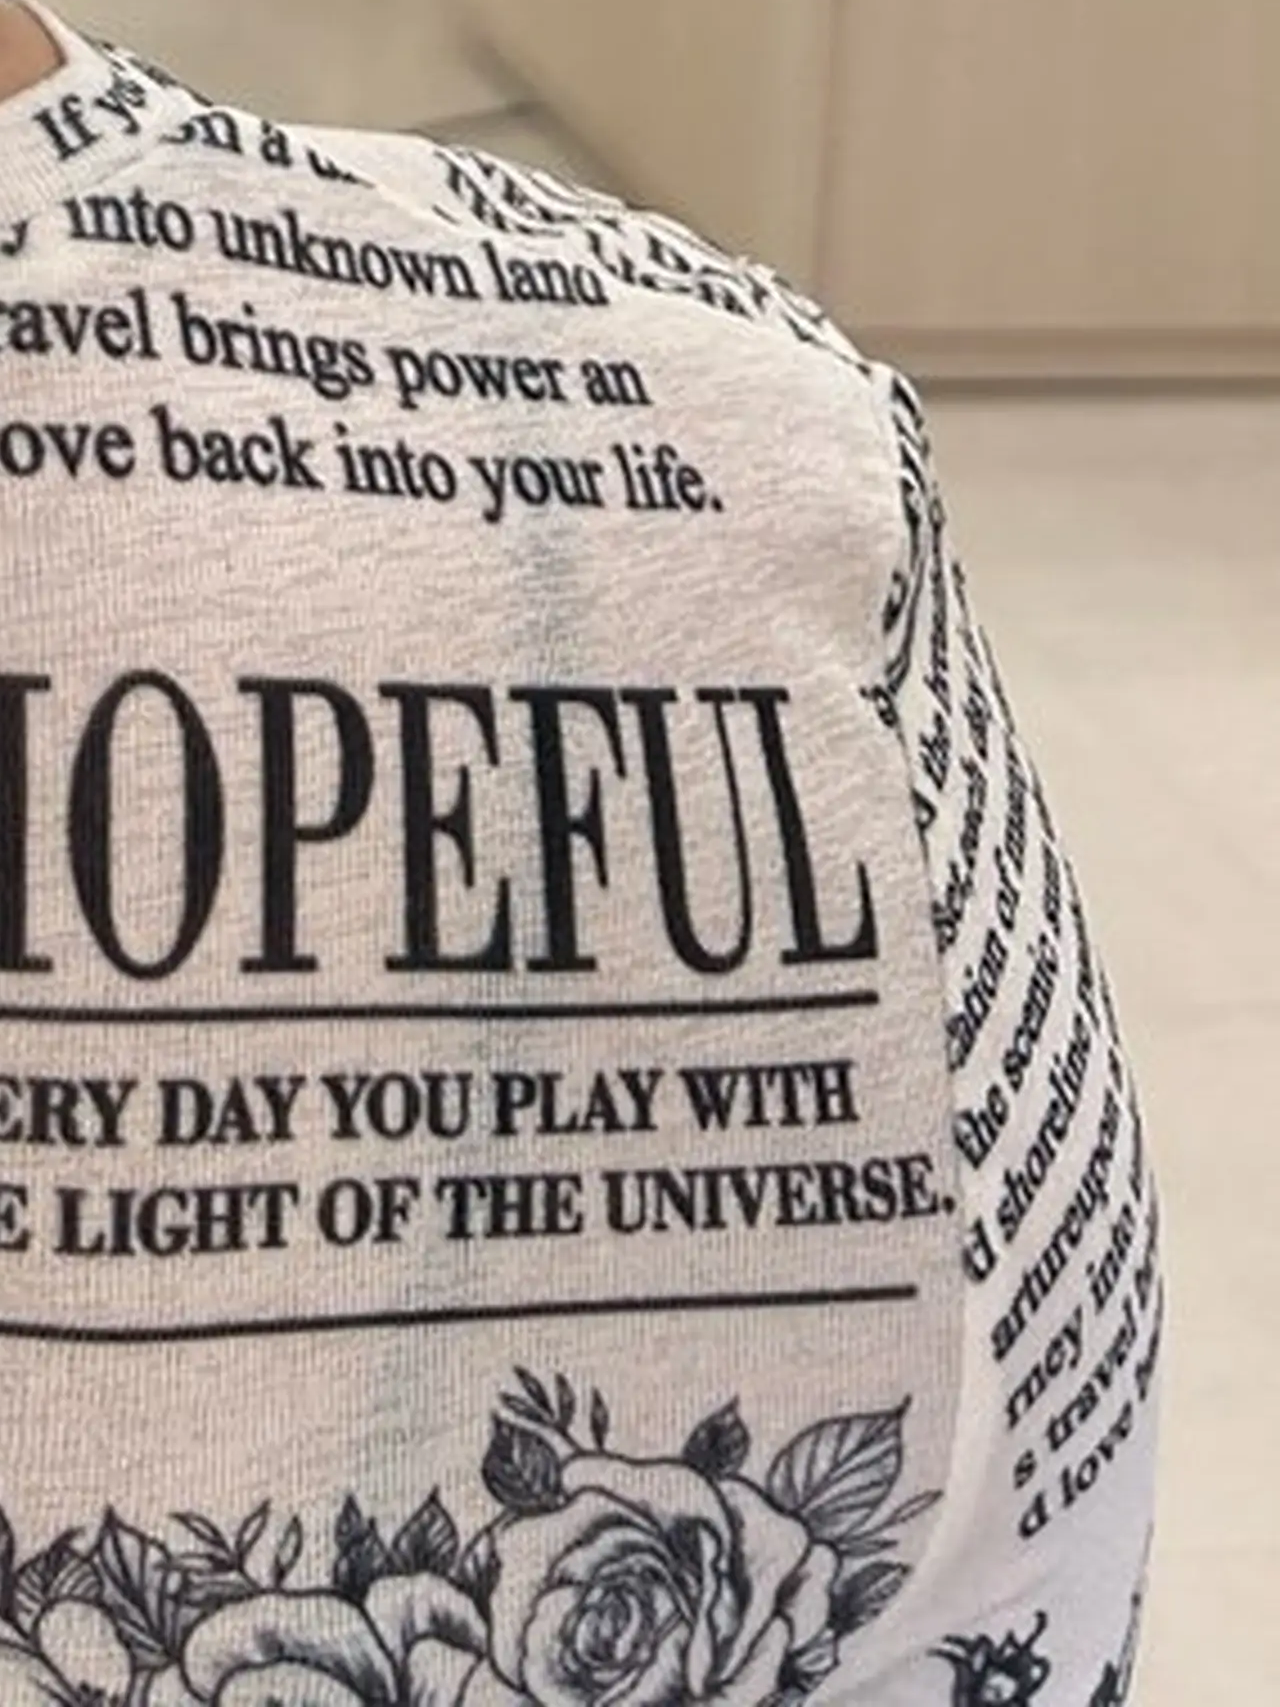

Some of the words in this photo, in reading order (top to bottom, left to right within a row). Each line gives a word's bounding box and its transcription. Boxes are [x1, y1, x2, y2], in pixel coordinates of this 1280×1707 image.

[62, 187, 194, 252] into
[208, 207, 481, 301] unknown
[170, 289, 374, 402] brings
[385, 344, 569, 411] power
[579, 358, 655, 406] an
[150, 402, 326, 491] back
[334, 422, 458, 503] into
[468, 453, 605, 524] your
[609, 441, 725, 514] life.
[156, 1075, 306, 1147] DAY
[321, 1069, 473, 1141] YOU
[492, 1067, 665, 1137] PLAY
[677, 1057, 860, 1132] WITH
[53, 1182, 299, 1258] LIGHT
[317, 1176, 420, 1247] OF
[434, 1172, 586, 1240] THE
[599, 1152, 957, 1234] UNIVERSE.
[1044, 1292, 1138, 1453] travel
